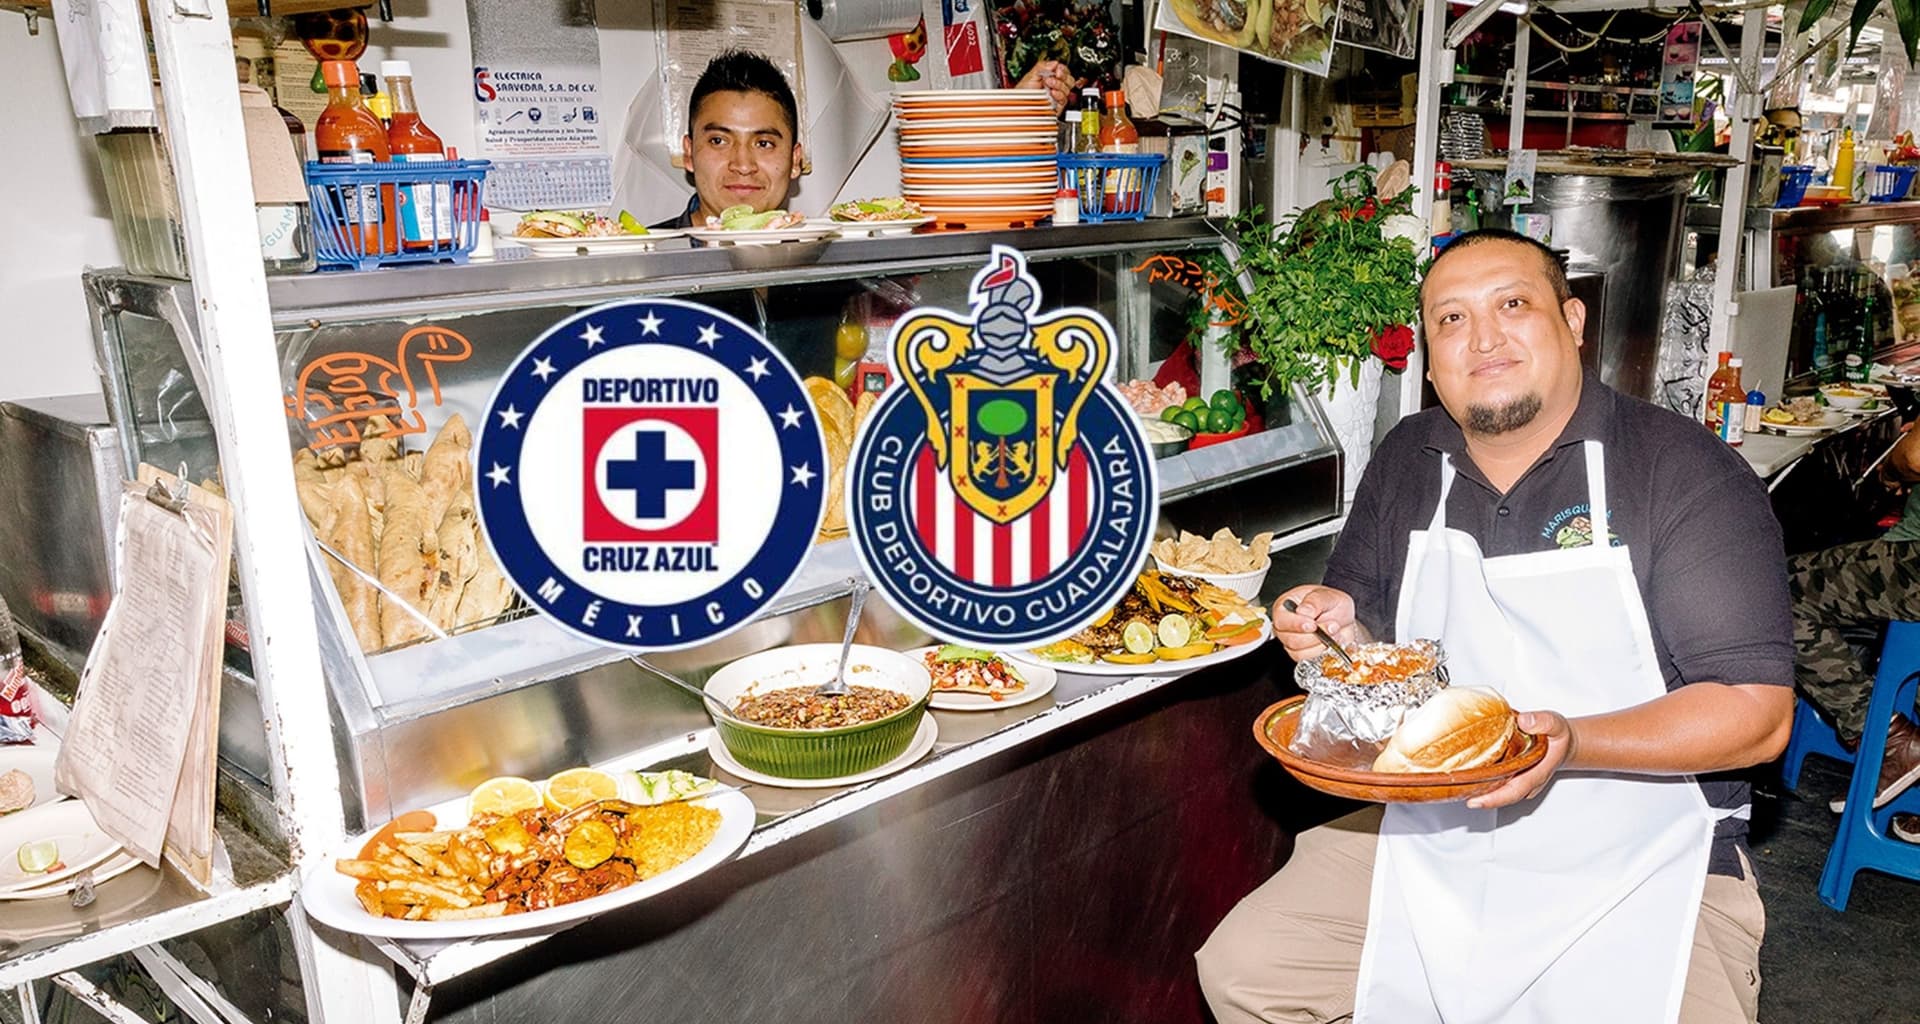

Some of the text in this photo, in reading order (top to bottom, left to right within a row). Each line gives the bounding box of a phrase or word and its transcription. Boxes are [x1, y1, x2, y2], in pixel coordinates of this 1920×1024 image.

[494, 72, 542, 80] ELECTRICA
[569, 84, 579, 92] DE
[1541, 503, 1613, 539] MARISQUA
